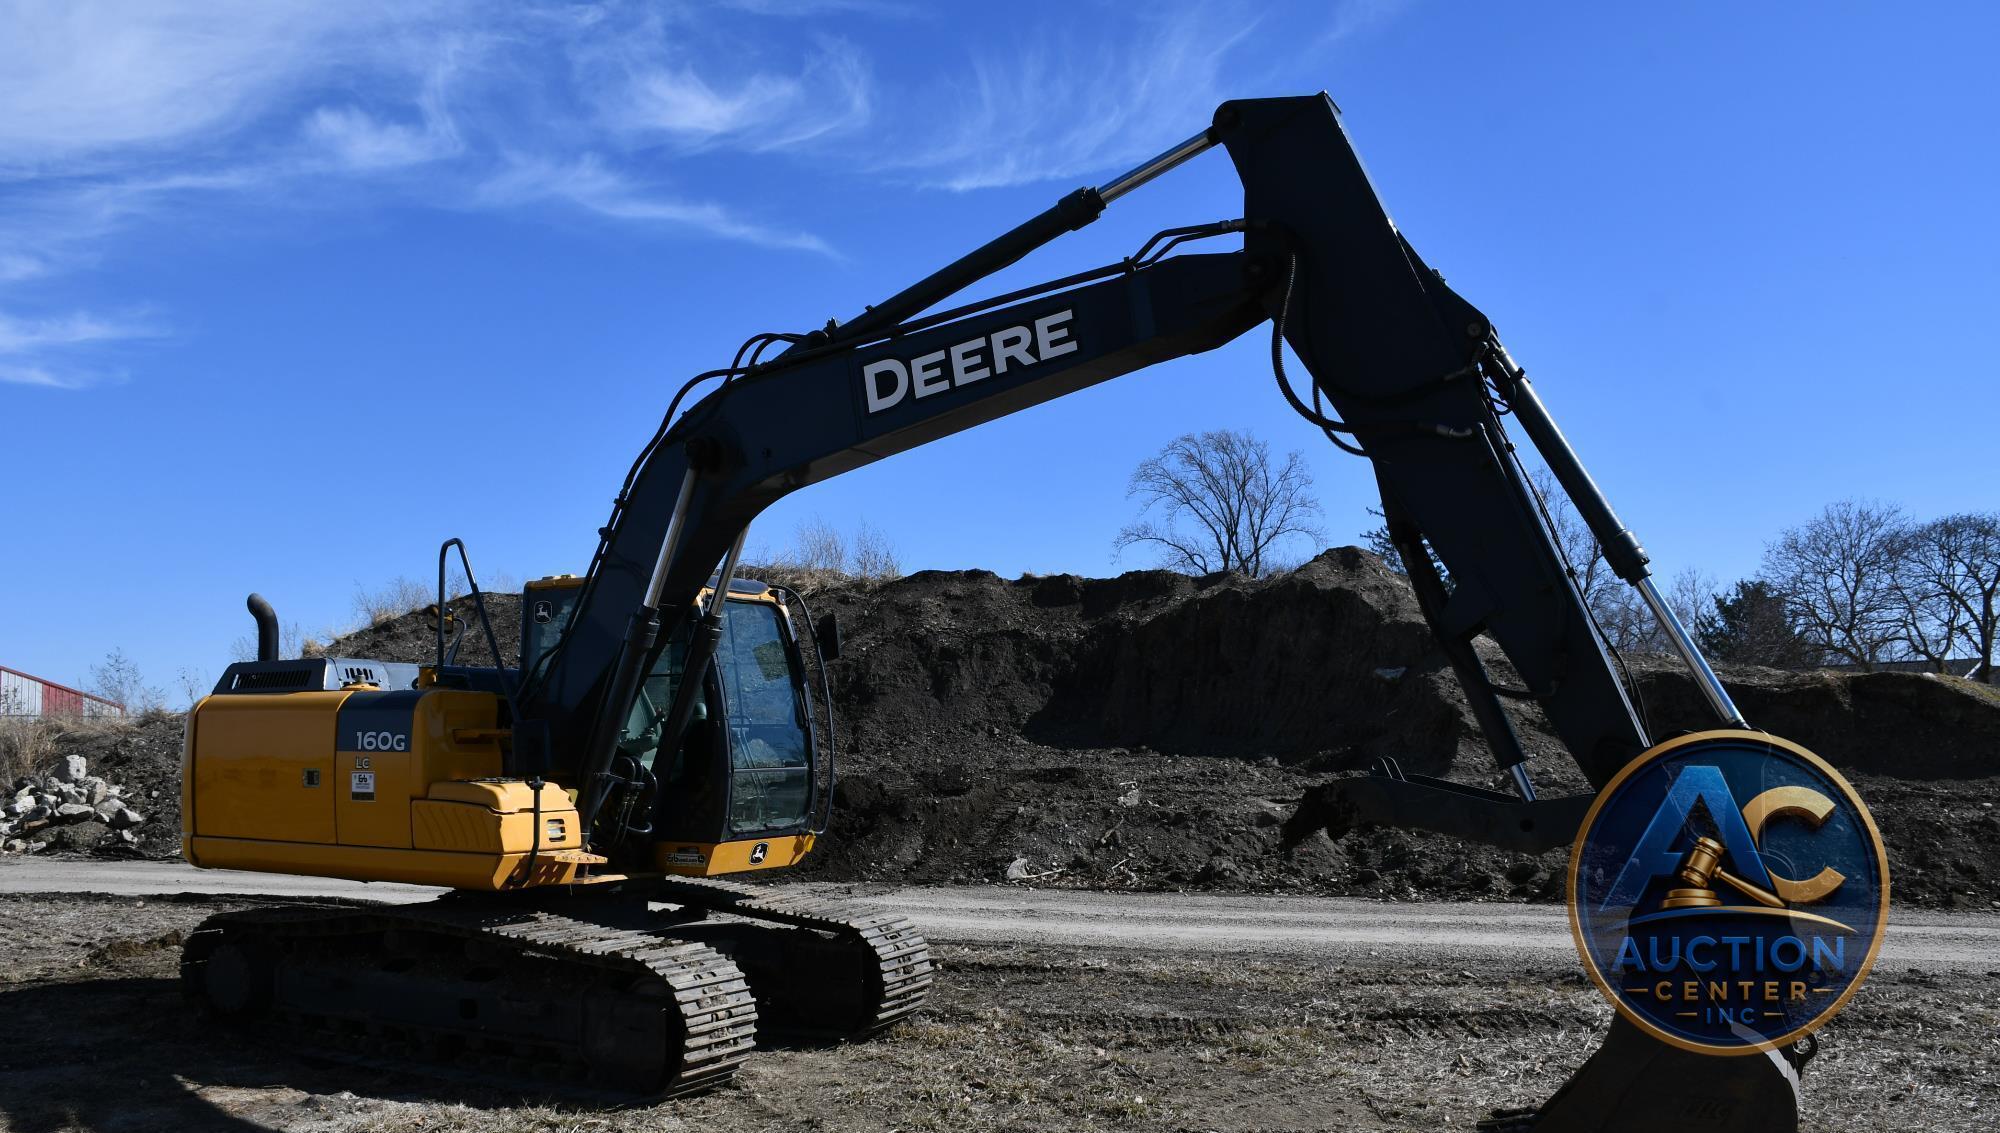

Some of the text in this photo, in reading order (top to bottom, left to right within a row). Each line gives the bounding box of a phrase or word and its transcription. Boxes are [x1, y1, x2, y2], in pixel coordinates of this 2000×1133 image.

[863, 309, 1078, 414] DEERE
[356, 731, 406, 751] 160G
[355, 757, 370, 769] LC
